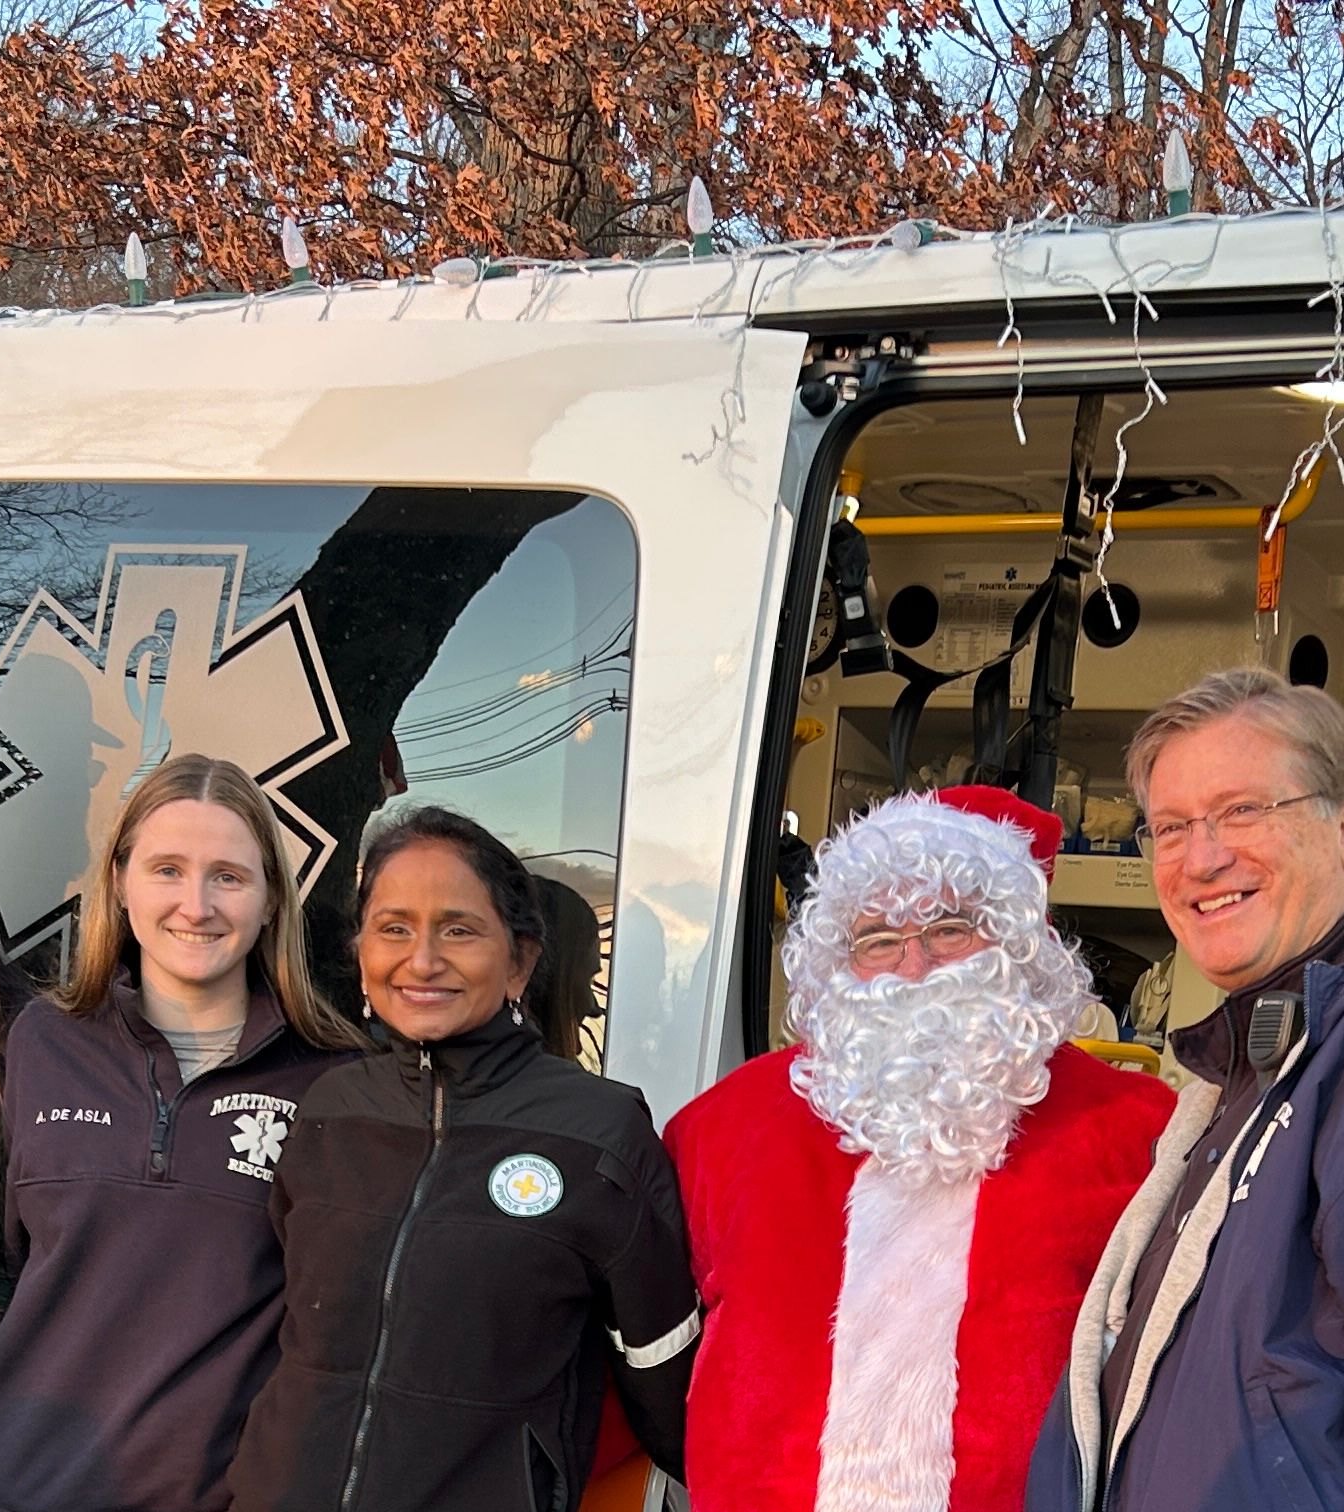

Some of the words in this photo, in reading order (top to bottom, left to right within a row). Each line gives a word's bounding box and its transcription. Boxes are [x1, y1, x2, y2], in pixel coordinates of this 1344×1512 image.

[36, 1110, 47, 1124] A.
[50, 1108, 71, 1121] DE
[74, 1108, 111, 1126] ASLA
[210, 1093, 298, 1122] MARTINSVI
[227, 1157, 275, 1182] RESCU
